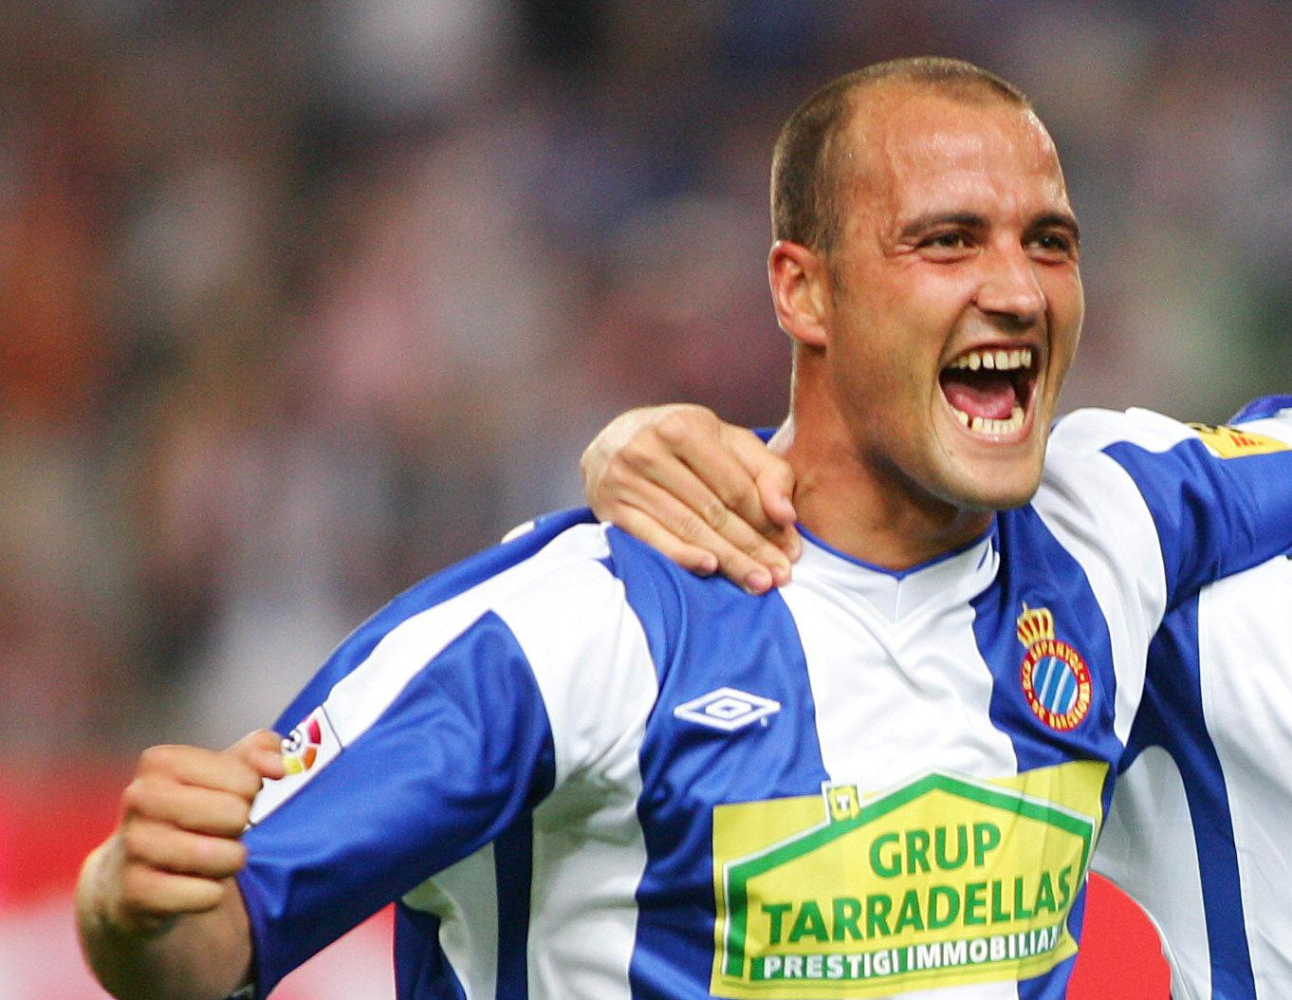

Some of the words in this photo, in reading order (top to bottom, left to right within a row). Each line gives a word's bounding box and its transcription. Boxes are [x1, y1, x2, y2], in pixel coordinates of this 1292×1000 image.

[869, 822, 1001, 878] GRUP
[761, 865, 1072, 945] TARRADELLAS
[763, 948, 899, 979] PRESTIGI
